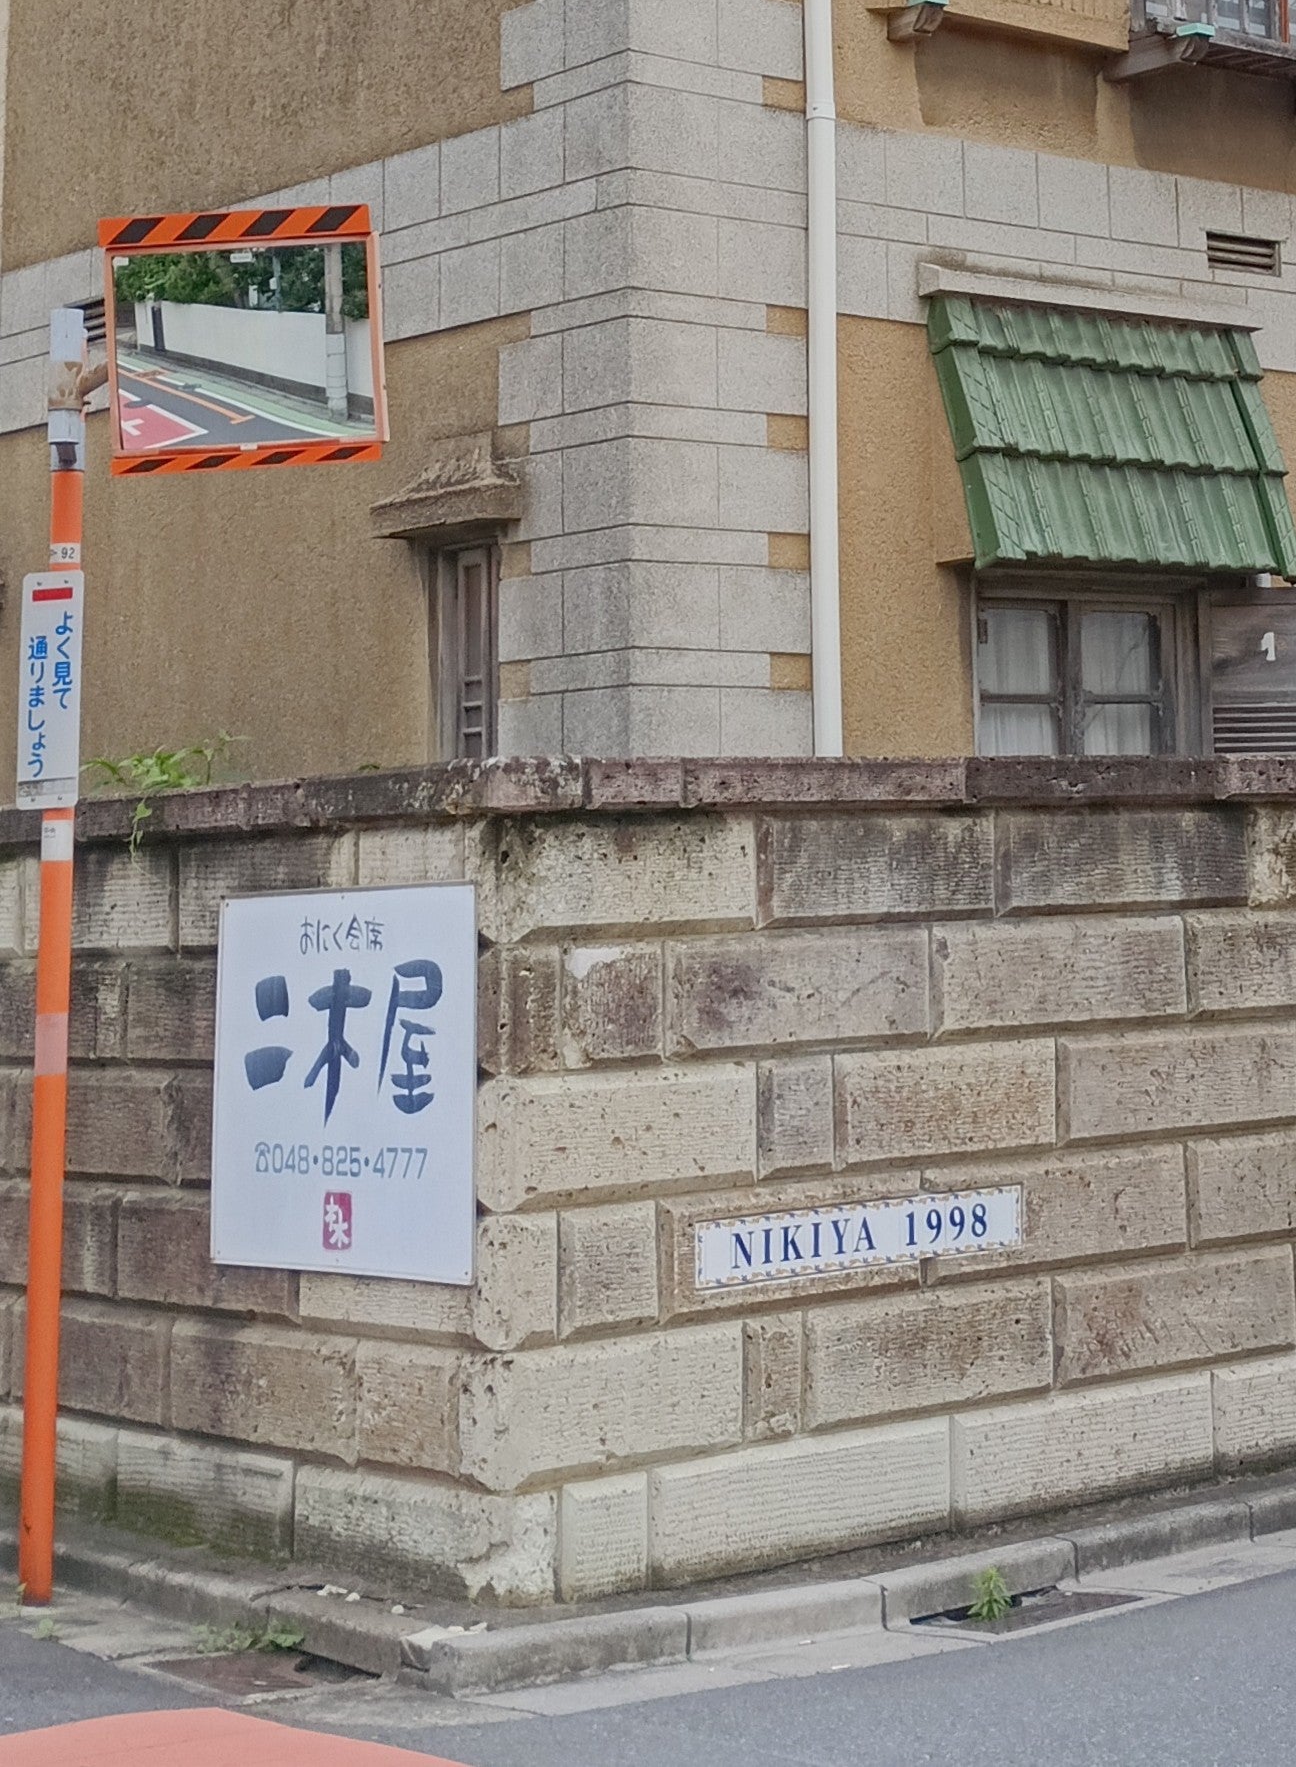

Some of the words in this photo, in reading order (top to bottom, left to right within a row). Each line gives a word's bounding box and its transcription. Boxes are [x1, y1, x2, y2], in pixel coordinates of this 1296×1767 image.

[61, 546, 76, 560] 92
[52, 610, 74, 710] よく見て
[27, 636, 48, 778] 通りましょう
[300, 914, 385, 955] おにく会席
[244, 959, 443, 1127] 二木屋
[731, 1217, 877, 1270] NIKIYA
[905, 1202, 988, 1247] 1998
